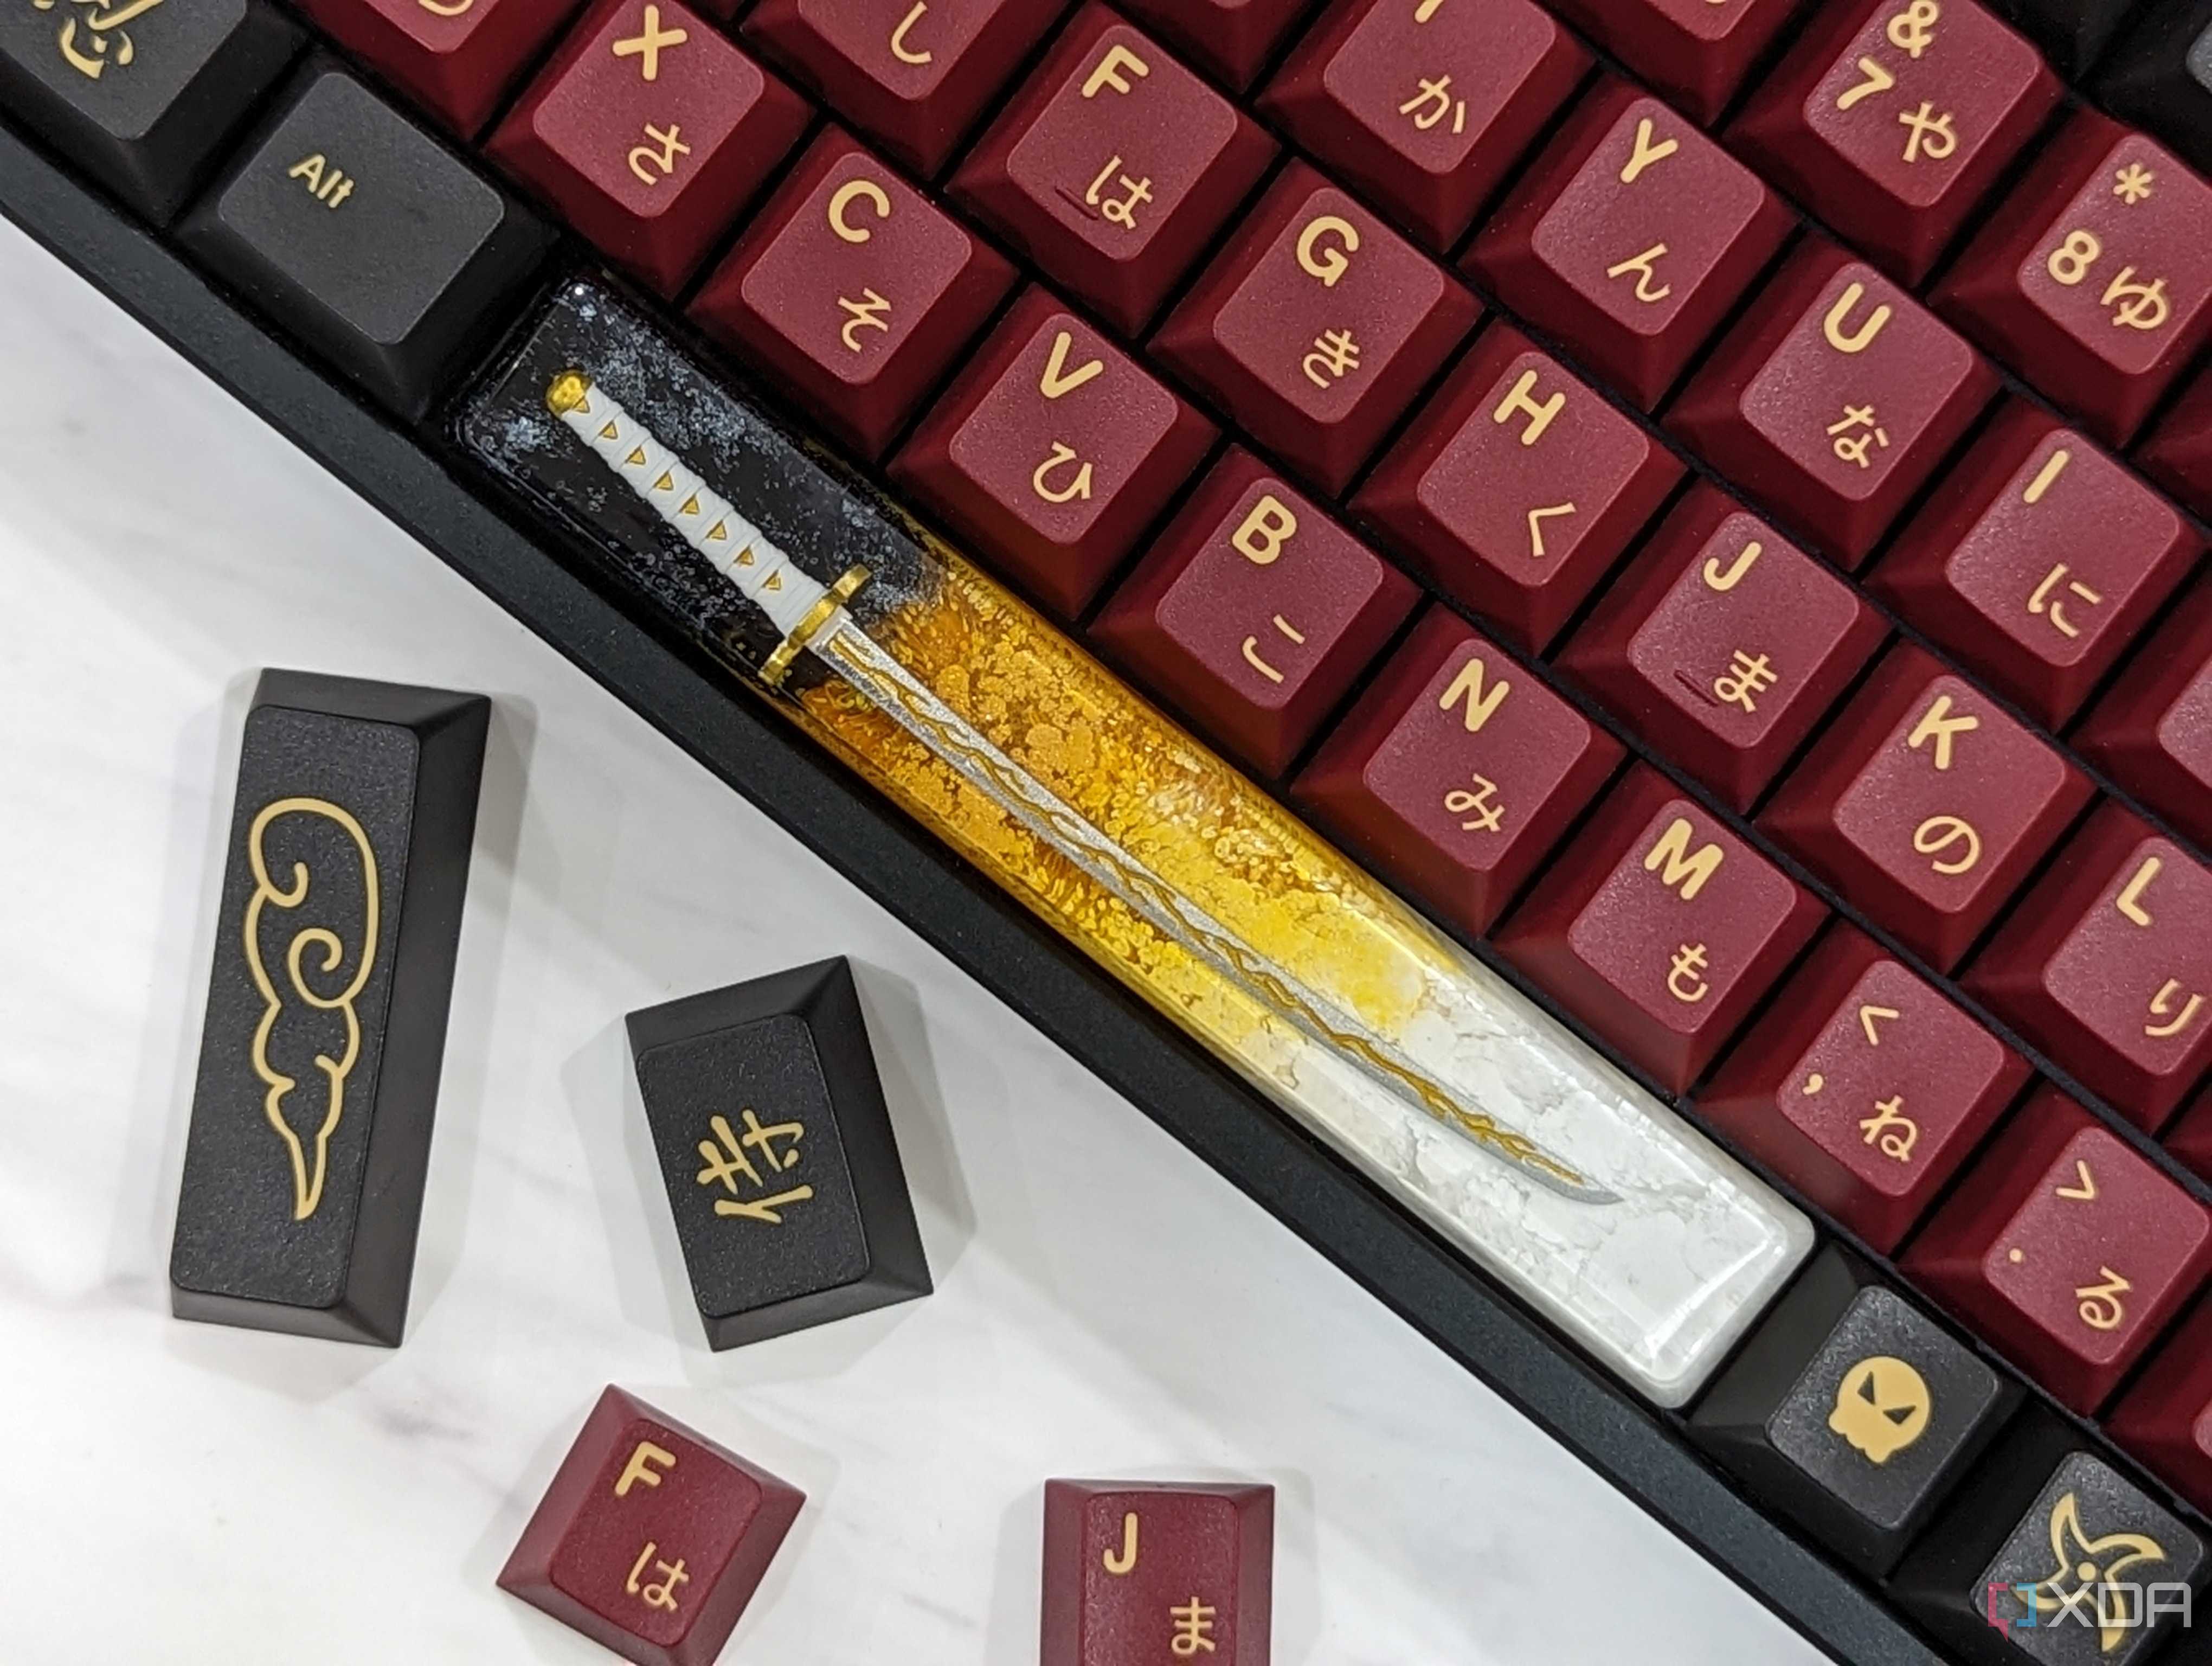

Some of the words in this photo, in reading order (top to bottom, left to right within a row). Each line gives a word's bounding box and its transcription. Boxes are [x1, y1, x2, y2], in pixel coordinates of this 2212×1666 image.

[612, 4, 689, 81] X
[890, 1, 932, 65] し
[1886, 0, 1940, 59] &
[1081, 44, 1150, 98] F
[1400, 76, 1466, 132] か
[1836, 56, 1895, 111] 7
[1898, 101, 1957, 163] や
[290, 155, 353, 206] Alt
[627, 123, 691, 186] さ
[1620, 118, 1679, 184] Y
[827, 180, 891, 244] C
[1085, 155, 1152, 229] は
[1296, 215, 1360, 287] G
[1607, 243, 1669, 303] ん
[2047, 229, 2102, 286] 8
[2101, 267, 2169, 330] ゆ
[840, 289, 891, 351] そ
[1823, 281, 1892, 354] U
[1039, 331, 1104, 399] V
[1302, 329, 1359, 388] き
[1493, 369, 1567, 446] H
[1827, 406, 1888, 467] な
[1032, 441, 1093, 503] ひ
[2022, 450, 2070, 504] I
[1231, 495, 1298, 565] B
[1527, 502, 1575, 557] く
[1702, 541, 1763, 592] J
[2027, 563, 2101, 638] に
[1242, 614, 1303, 684] こ
[1438, 658, 1510, 733] N
[1713, 651, 1778, 712] ま
[1907, 694, 1979, 771] K
[1443, 773, 1506, 832] み
[1643, 817, 1725, 901] M
[1913, 815, 1981, 875] の
[2115, 856, 2163, 927] L
[1668, 944, 1708, 1003] も
[2145, 979, 2202, 1037] り
[1860, 1097, 1918, 1162] ね
[696, 1110, 814, 1223] 侍
[2076, 1267, 2131, 1330] る
[614, 1441, 677, 1497] F
[1102, 1511, 1139, 1575] J
[626, 1542, 690, 1611] は
[1169, 1597, 1216, 1656] ま
